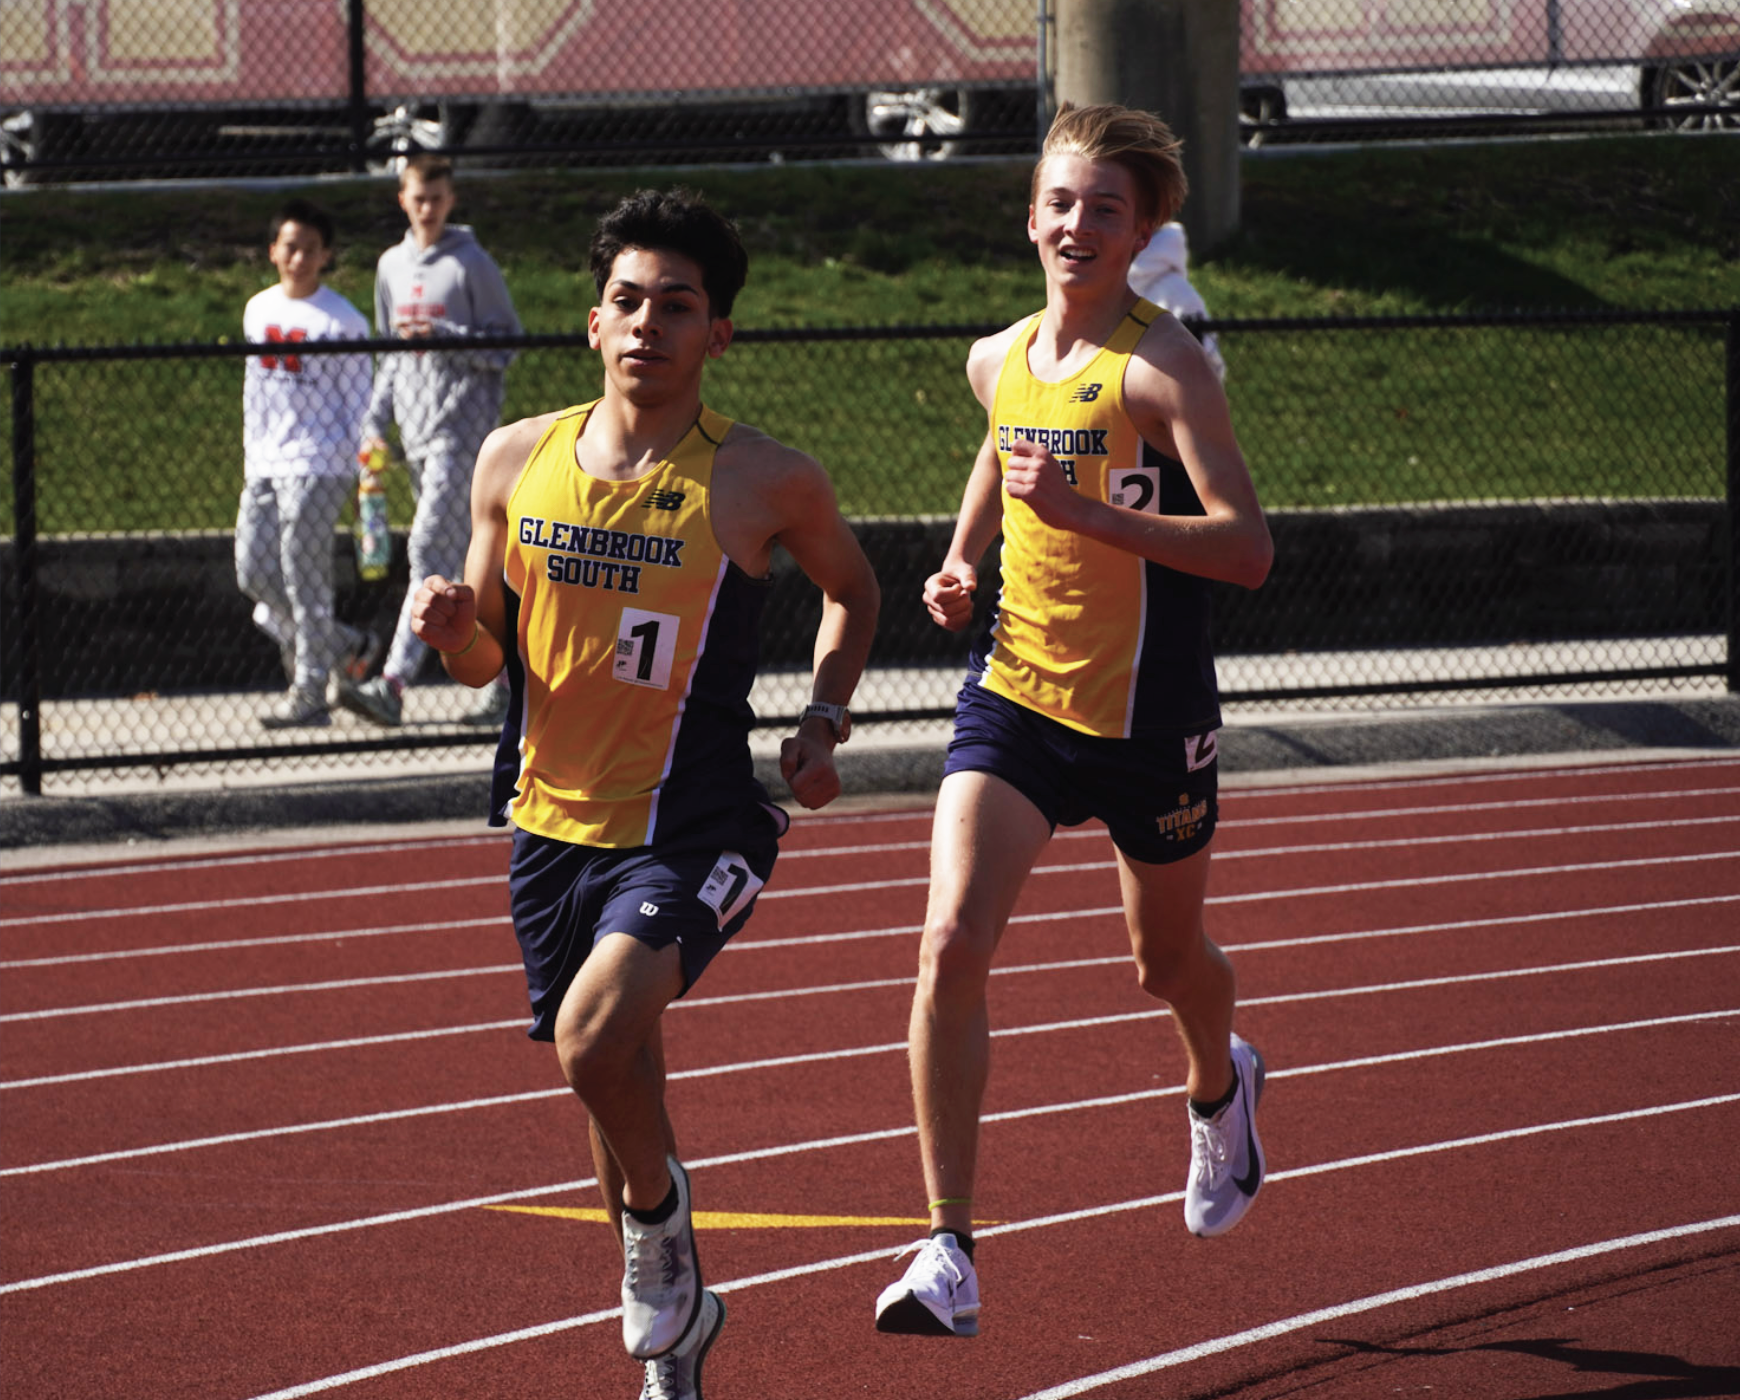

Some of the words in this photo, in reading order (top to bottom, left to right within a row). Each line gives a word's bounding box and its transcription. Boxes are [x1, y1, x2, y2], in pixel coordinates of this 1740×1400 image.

[1120, 474, 1155, 515] 2
[519, 517, 685, 568] GLENBROOK
[546, 554, 642, 594] SOUTH
[631, 620, 660, 681] 1
